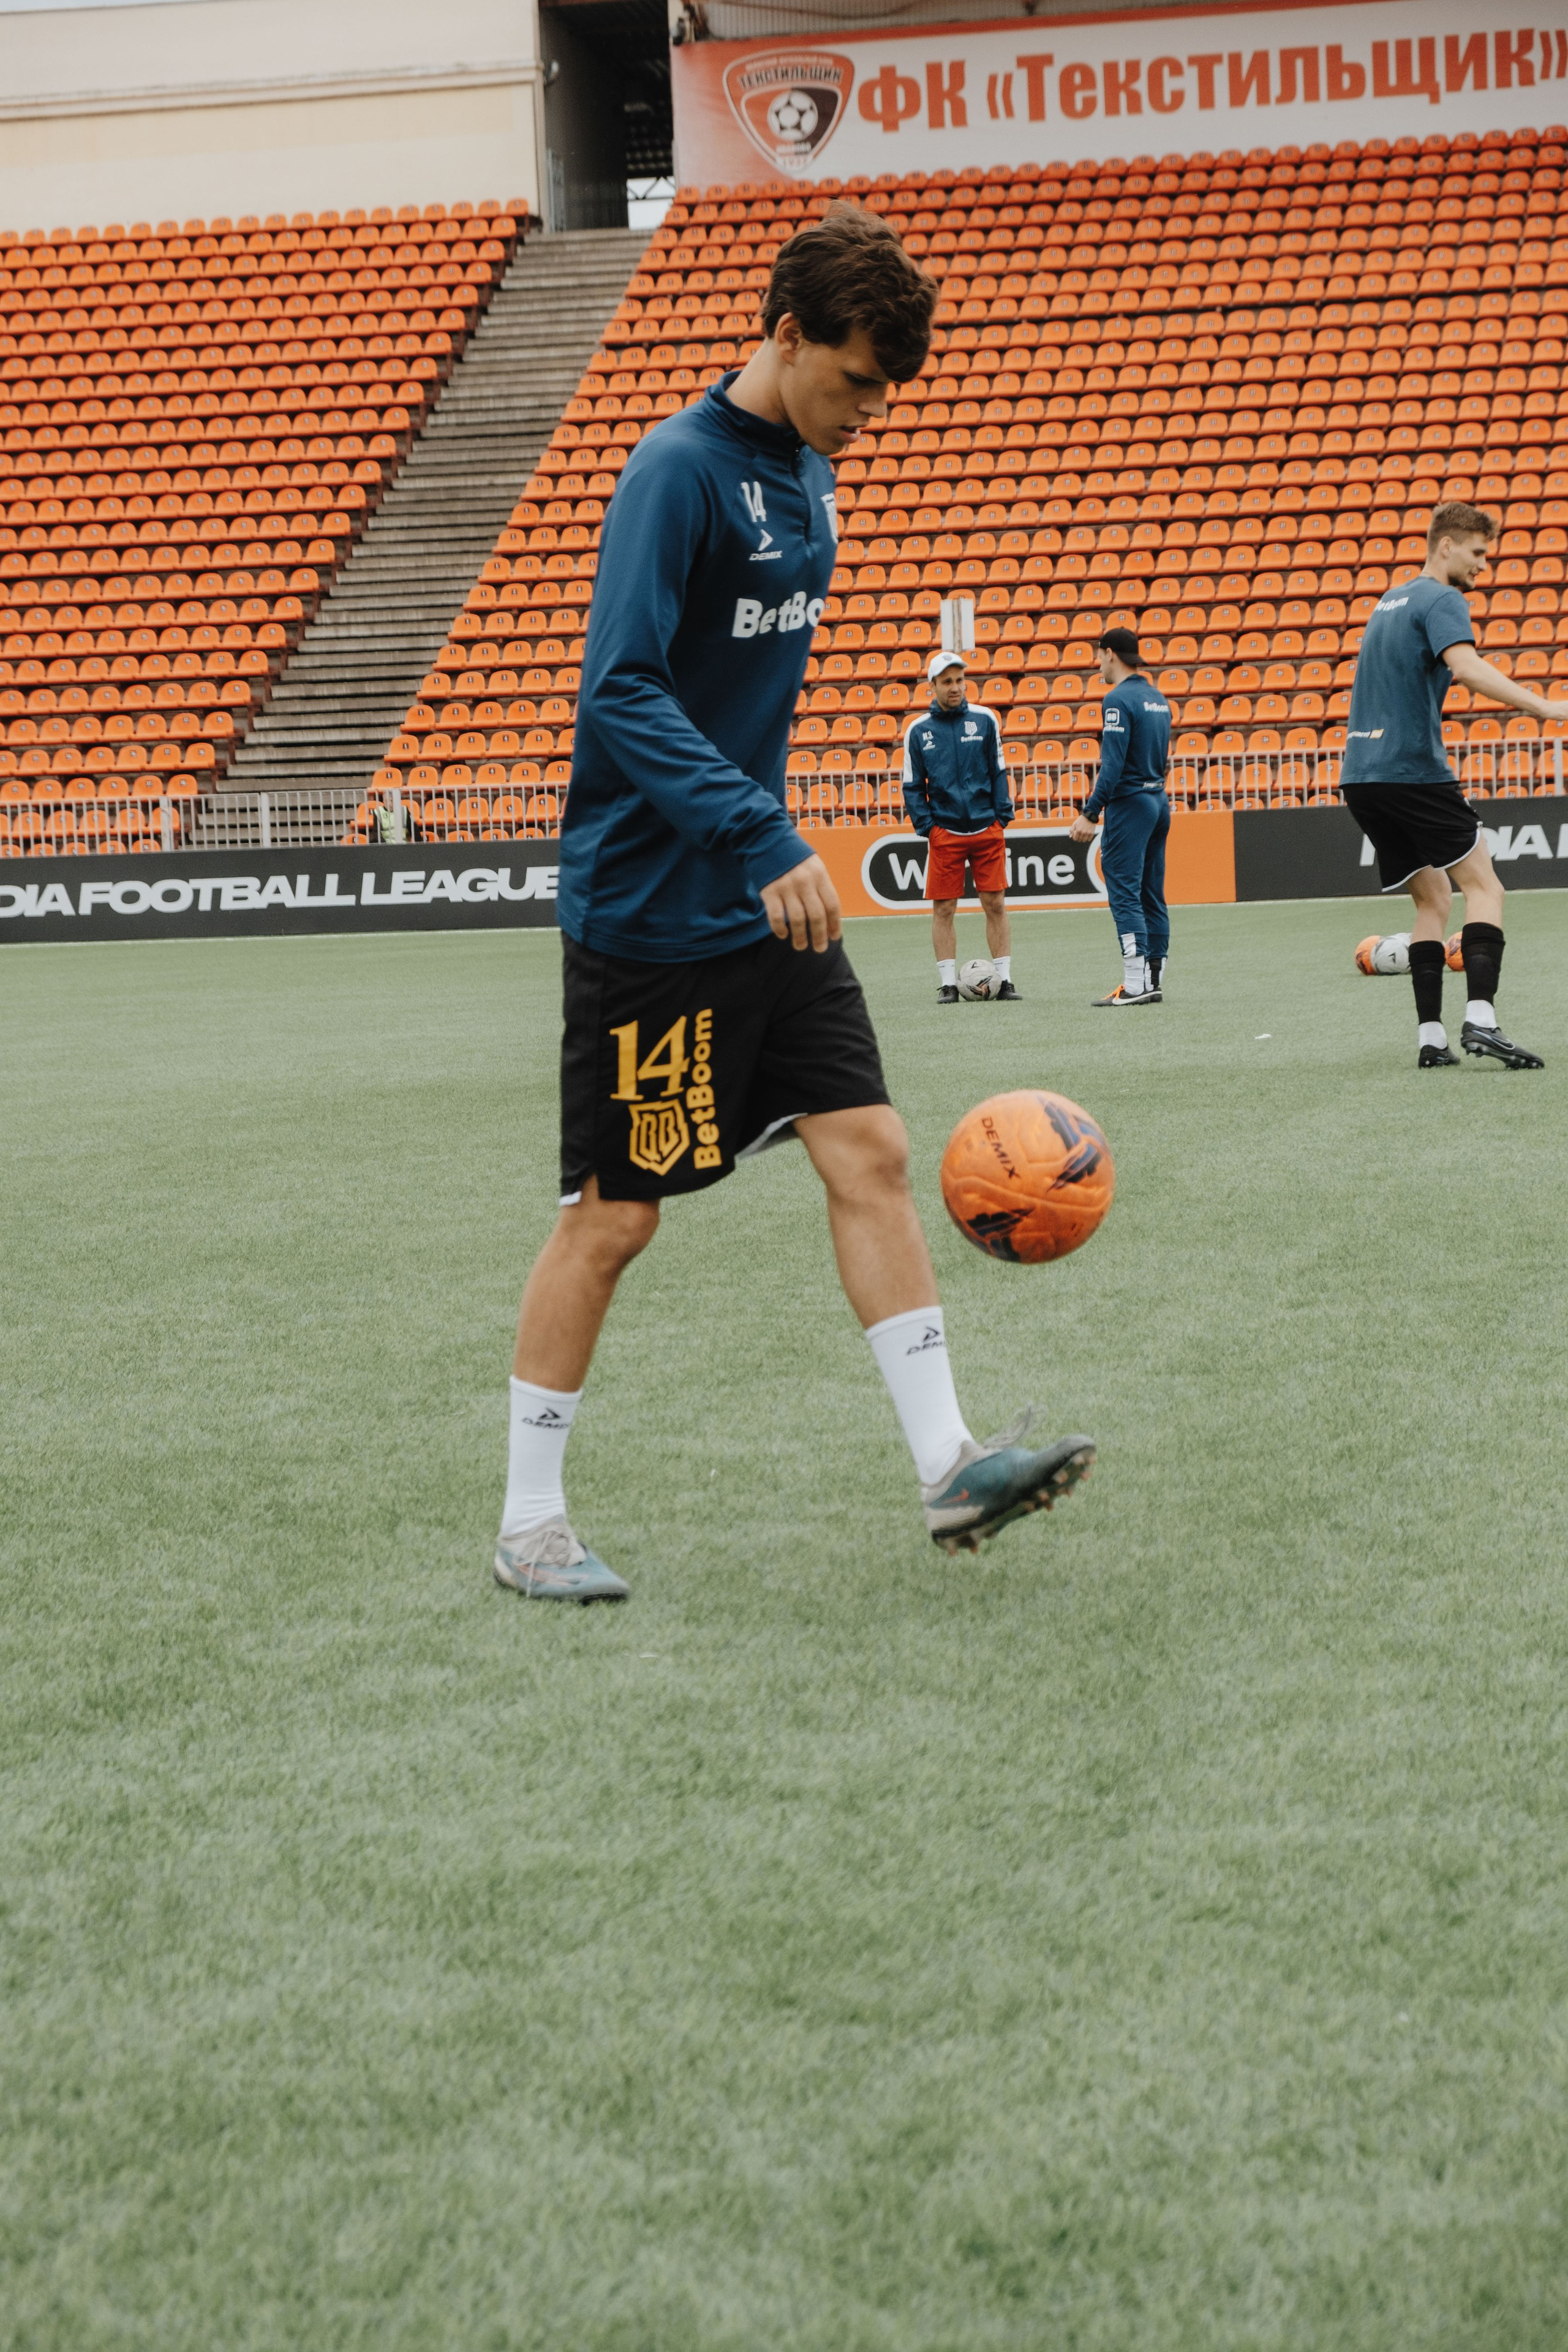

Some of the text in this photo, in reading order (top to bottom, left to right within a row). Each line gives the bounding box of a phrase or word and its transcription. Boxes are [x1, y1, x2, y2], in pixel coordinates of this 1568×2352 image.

[858, 59, 967, 134] ФК
[741, 481, 766, 522] 14
[748, 550, 783, 561] DEMIX
[1143, 701, 1169, 712] BetBoom
[78, 873, 355, 916] FOOTBALL
[361, 865, 560, 906] LEAGUE
[609, 1015, 690, 1101] 14
[685, 1008, 722, 1169] BetBoom
[981, 1116, 1021, 1180] DEMIX
